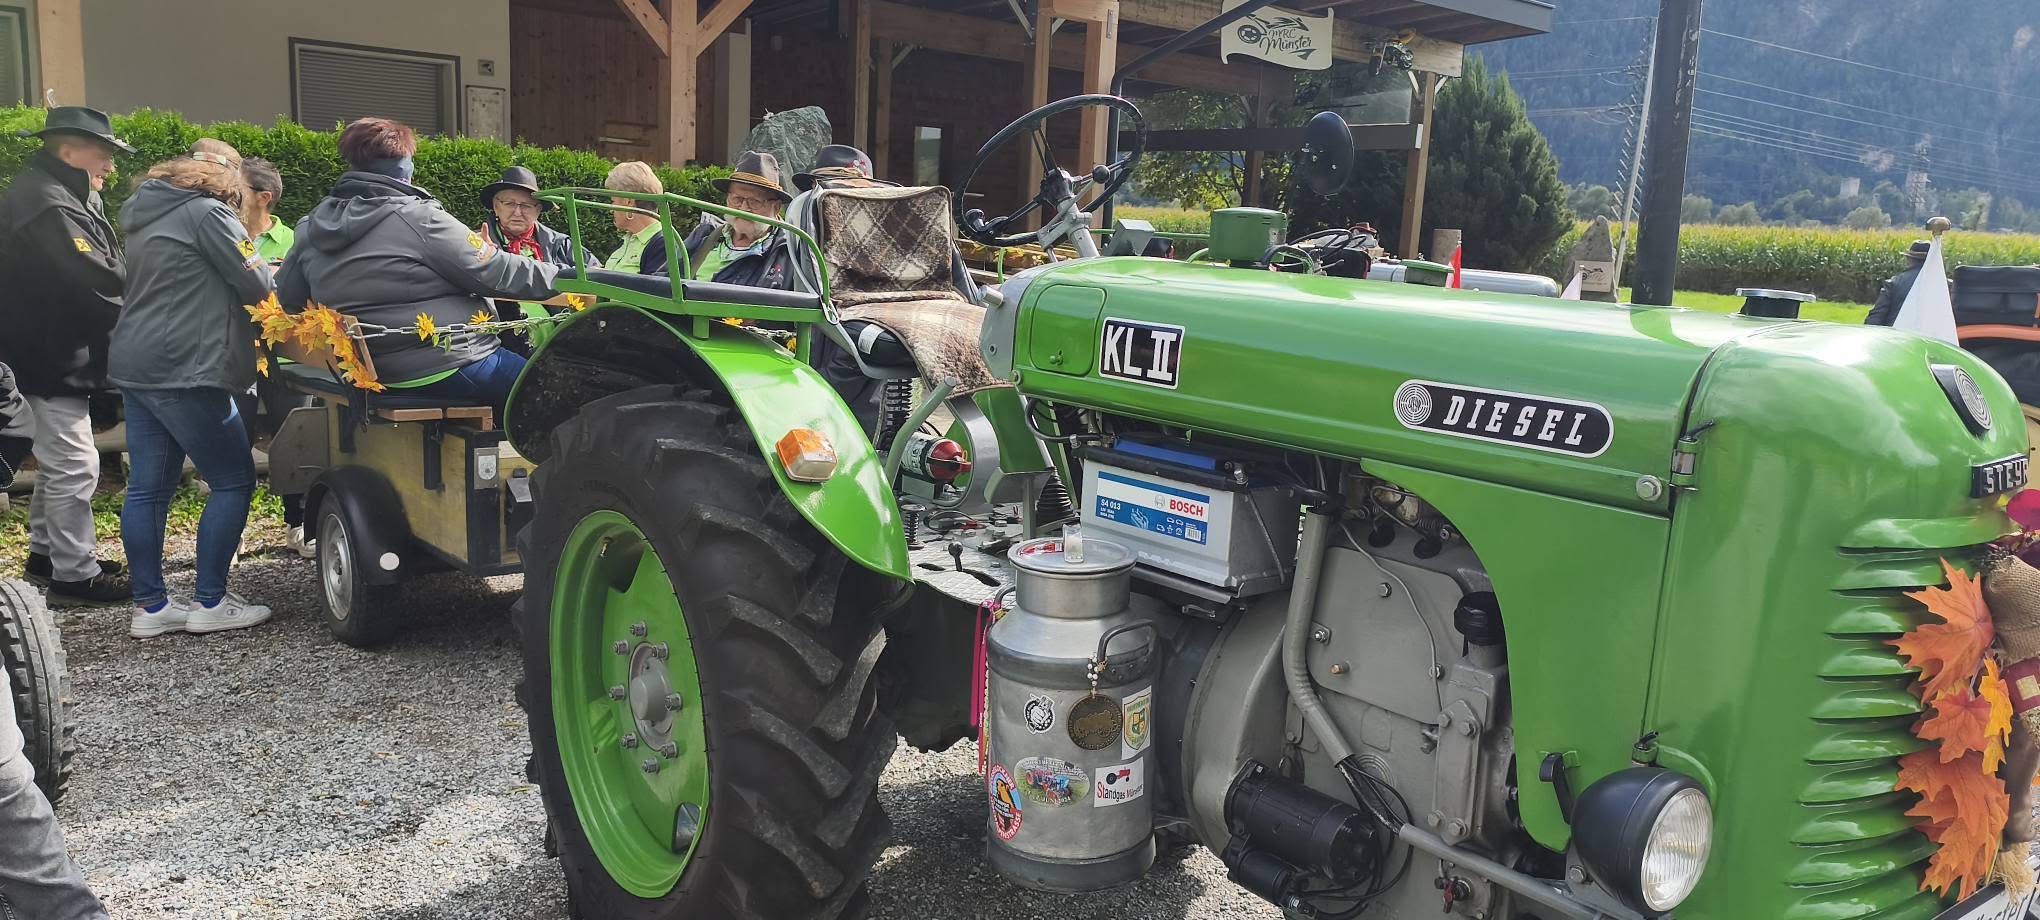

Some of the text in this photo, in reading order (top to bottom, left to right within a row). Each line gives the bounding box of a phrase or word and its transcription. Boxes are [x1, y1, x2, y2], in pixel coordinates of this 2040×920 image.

[1268, 28, 1296, 39] MRC
[1259, 35, 1312, 55] Münster
[1442, 395, 1587, 446] DIESEL
[1983, 458, 2028, 494] STEYR
[1109, 501, 1121, 510] 013
[1169, 499, 1204, 517] BOSCH
[1097, 781, 1126, 803] Standgas
